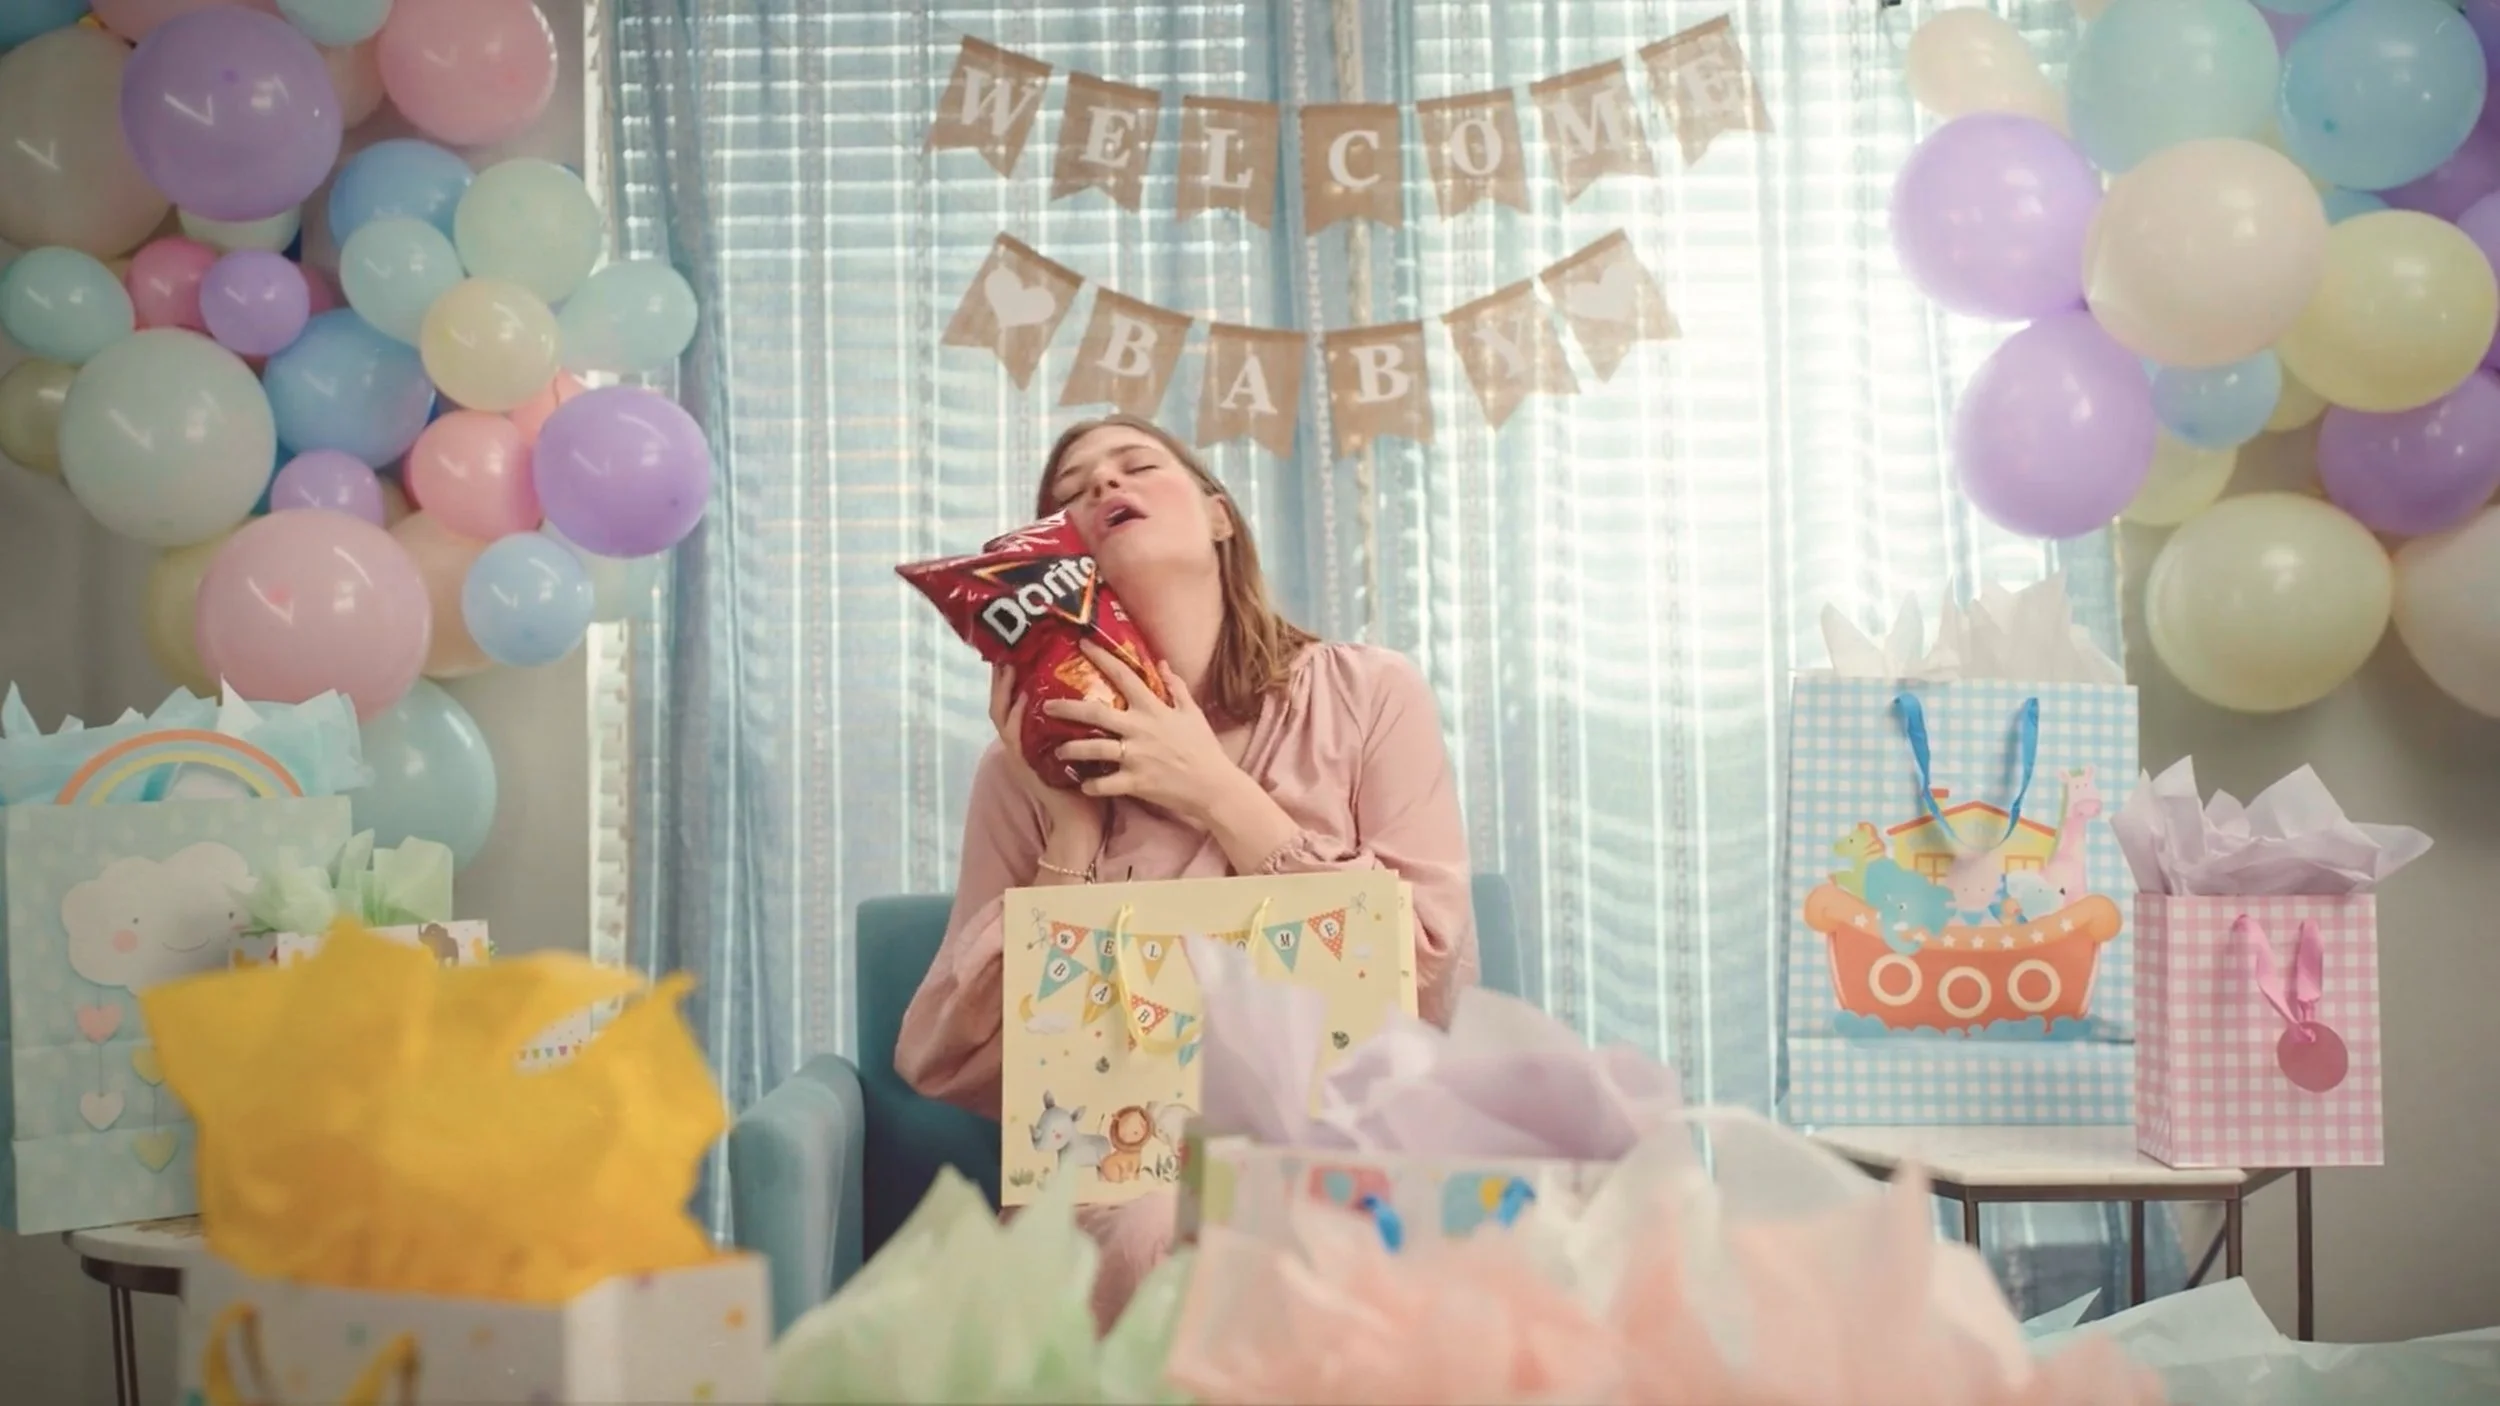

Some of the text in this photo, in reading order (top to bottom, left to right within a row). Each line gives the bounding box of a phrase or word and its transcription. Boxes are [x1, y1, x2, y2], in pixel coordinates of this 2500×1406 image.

[961, 52, 1742, 191] WELCOME
[1094, 311, 1527, 415] BABY
[982, 556, 1102, 646] Dorito
[1060, 920, 1338, 958] WELOME
[1053, 962, 1155, 1025] BAB
